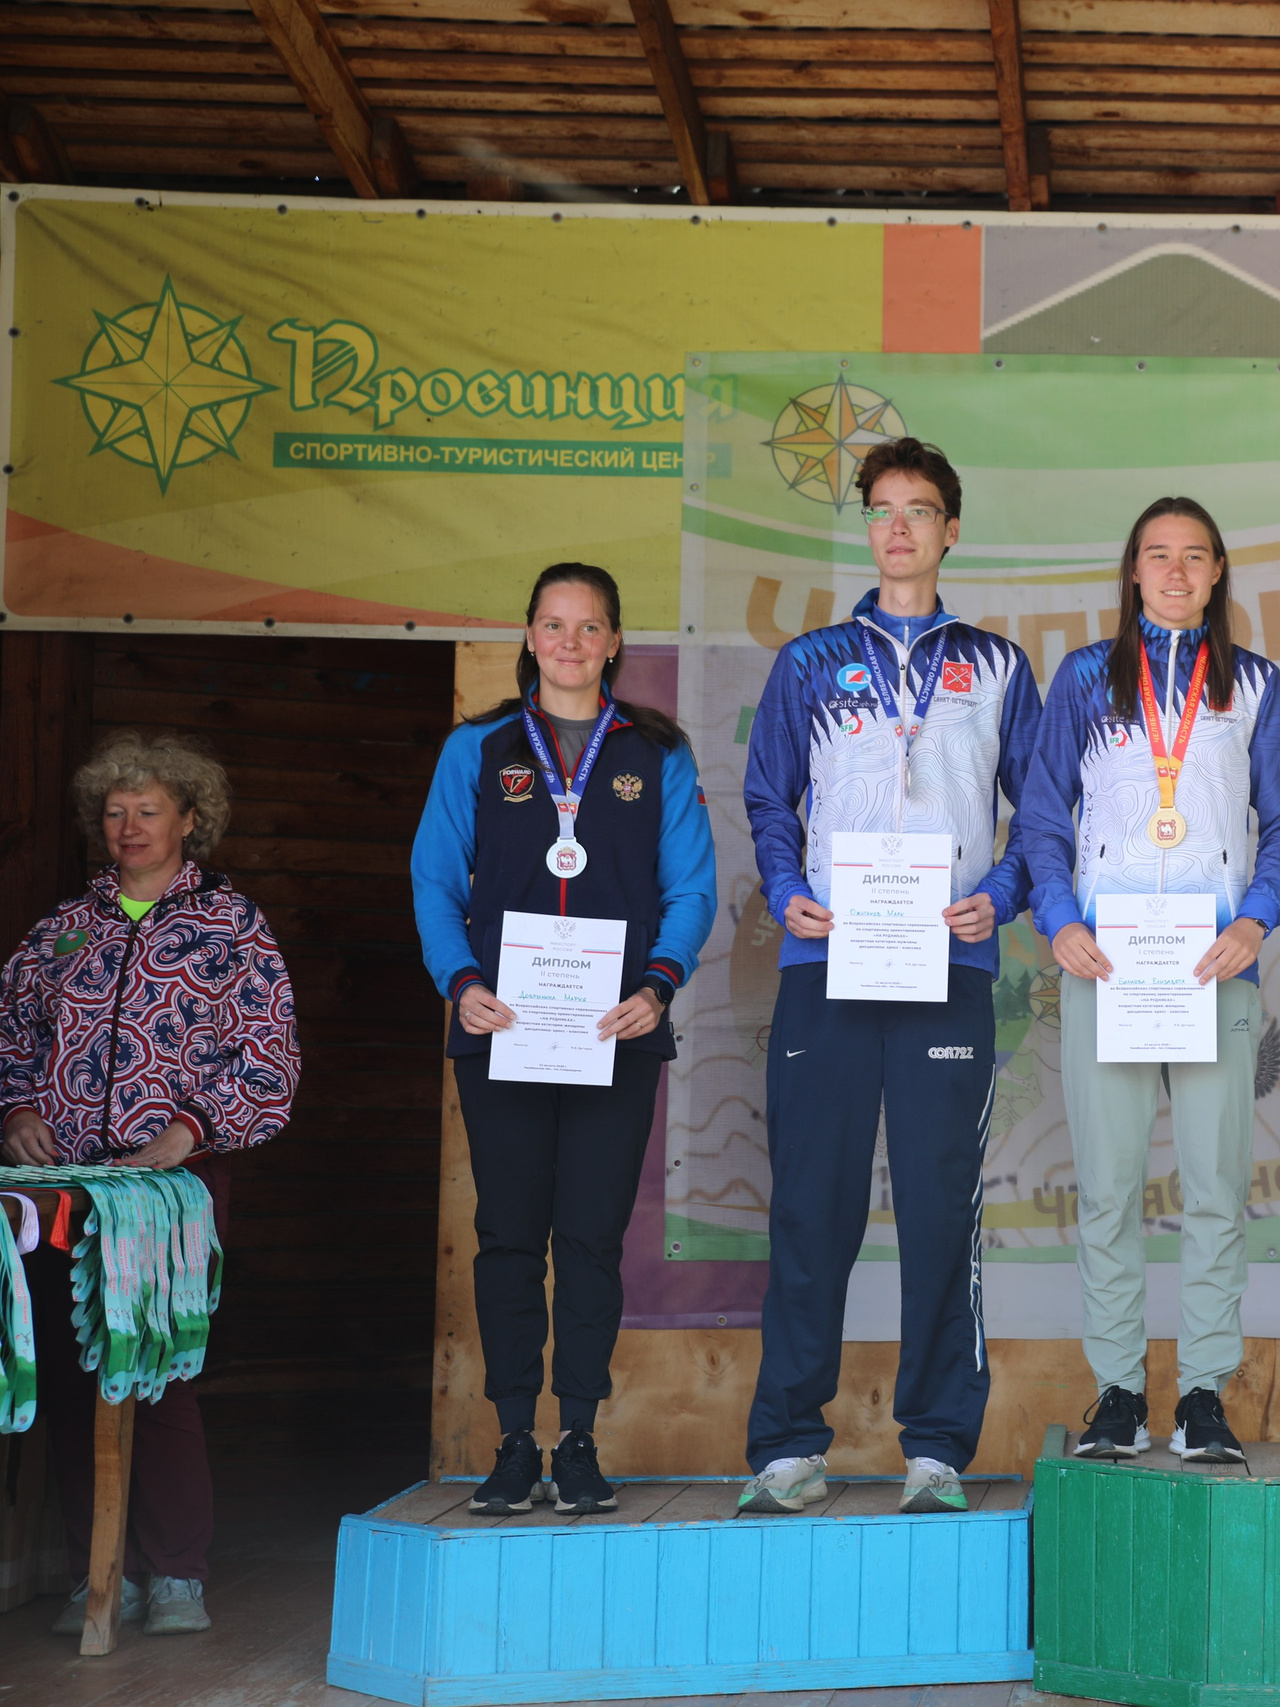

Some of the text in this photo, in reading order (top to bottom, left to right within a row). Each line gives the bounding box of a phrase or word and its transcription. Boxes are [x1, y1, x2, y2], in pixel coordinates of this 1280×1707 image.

[288, 441, 635, 470] СПОРТИВНО-ТУРИСТИЧЕСКИЙ
[870, 655, 891, 706] ЧЕЛЯБИНСКАЯ
[919, 673, 936, 704] ОБЛАСТЬ
[1178, 655, 1207, 744] ЧЕЛЯБИНСКАЯ ОБЛАСТЬ
[1142, 686, 1160, 743] ЧЕЛЯБИНСКАЯ
[840, 724, 853, 732] SFR
[578, 703, 616, 782] ЧЕЛЯБИНСКАЯ ОБЛАСТЬ
[502, 769, 532, 777] FORWARD
[863, 875, 920, 885] ДИПЛОМ
[1128, 936, 1185, 946] ДИПЛОМ
[532, 957, 591, 969] ДИПЛОМ
[547, 971, 580, 979] степень
